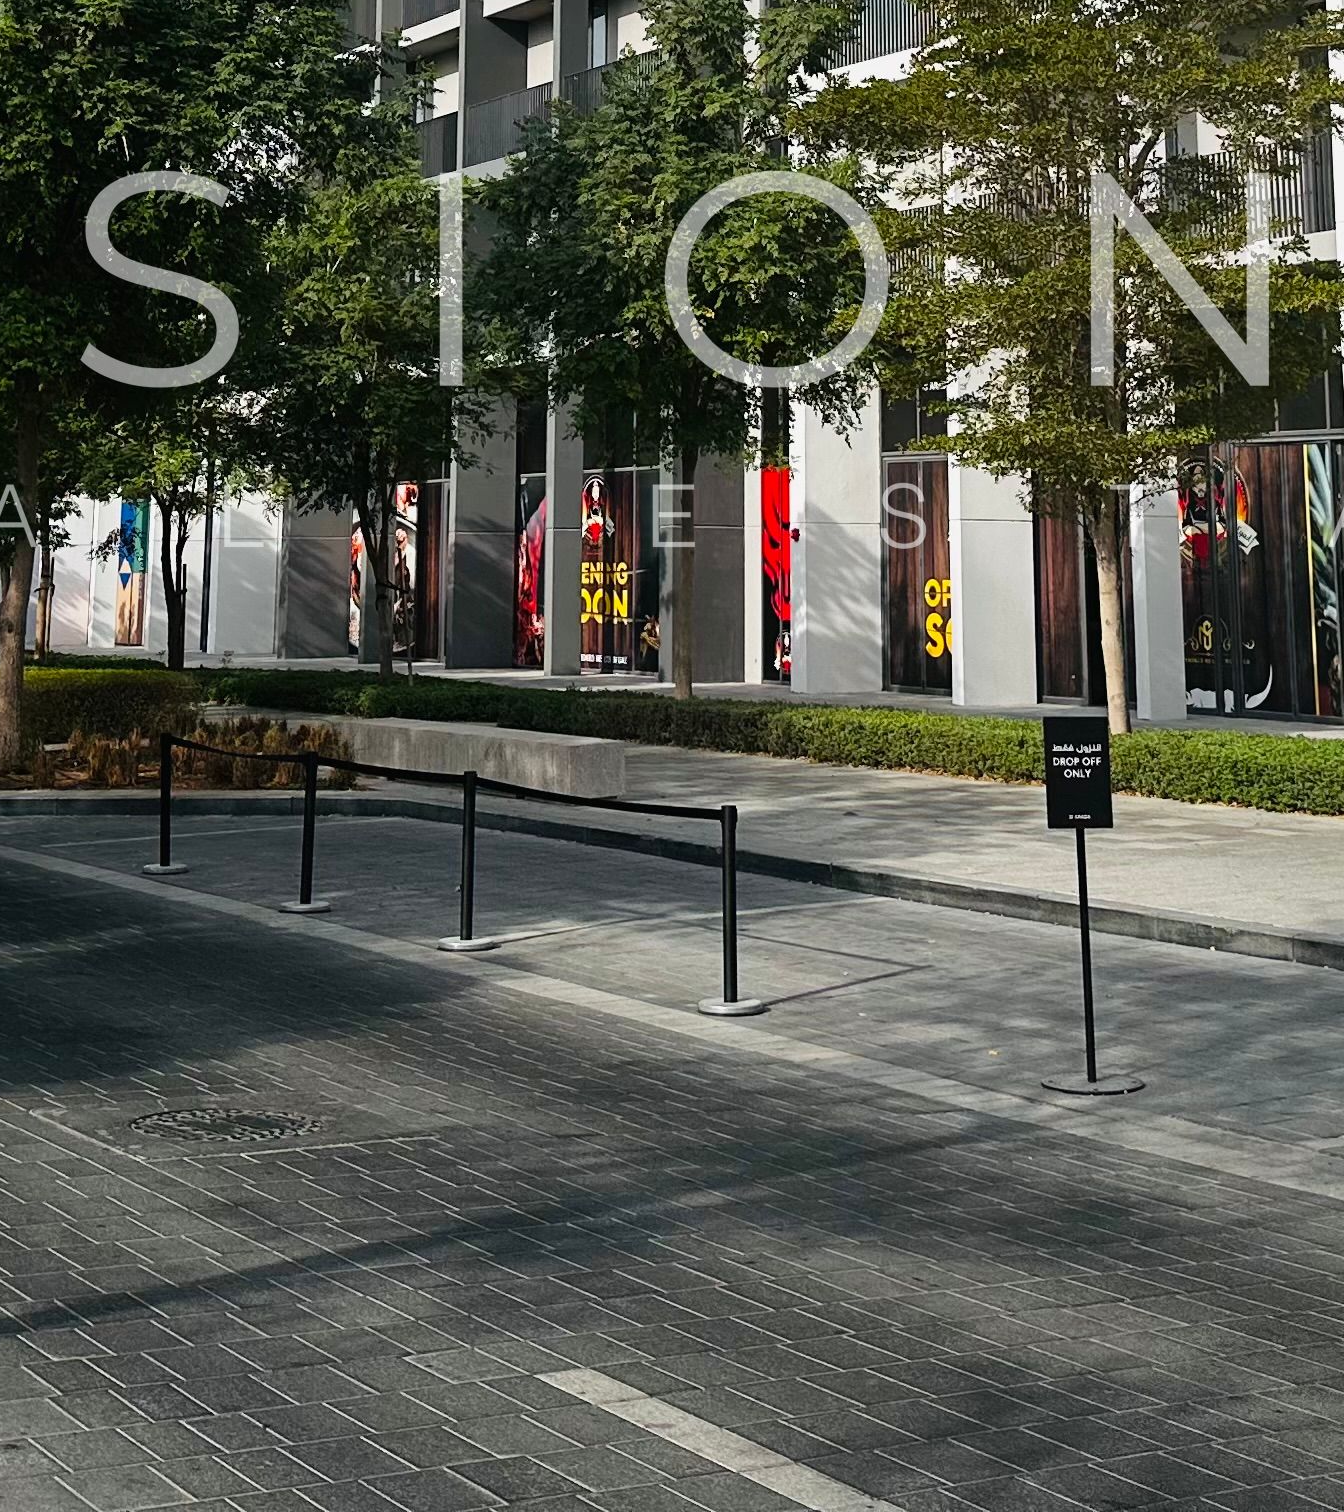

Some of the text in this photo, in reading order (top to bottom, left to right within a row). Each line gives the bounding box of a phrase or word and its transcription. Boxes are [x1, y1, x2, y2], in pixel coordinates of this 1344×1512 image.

[581, 561, 628, 585] ENING
[1053, 757, 1101, 766] DROP OFF
[1064, 769, 1091, 778] ONLY
